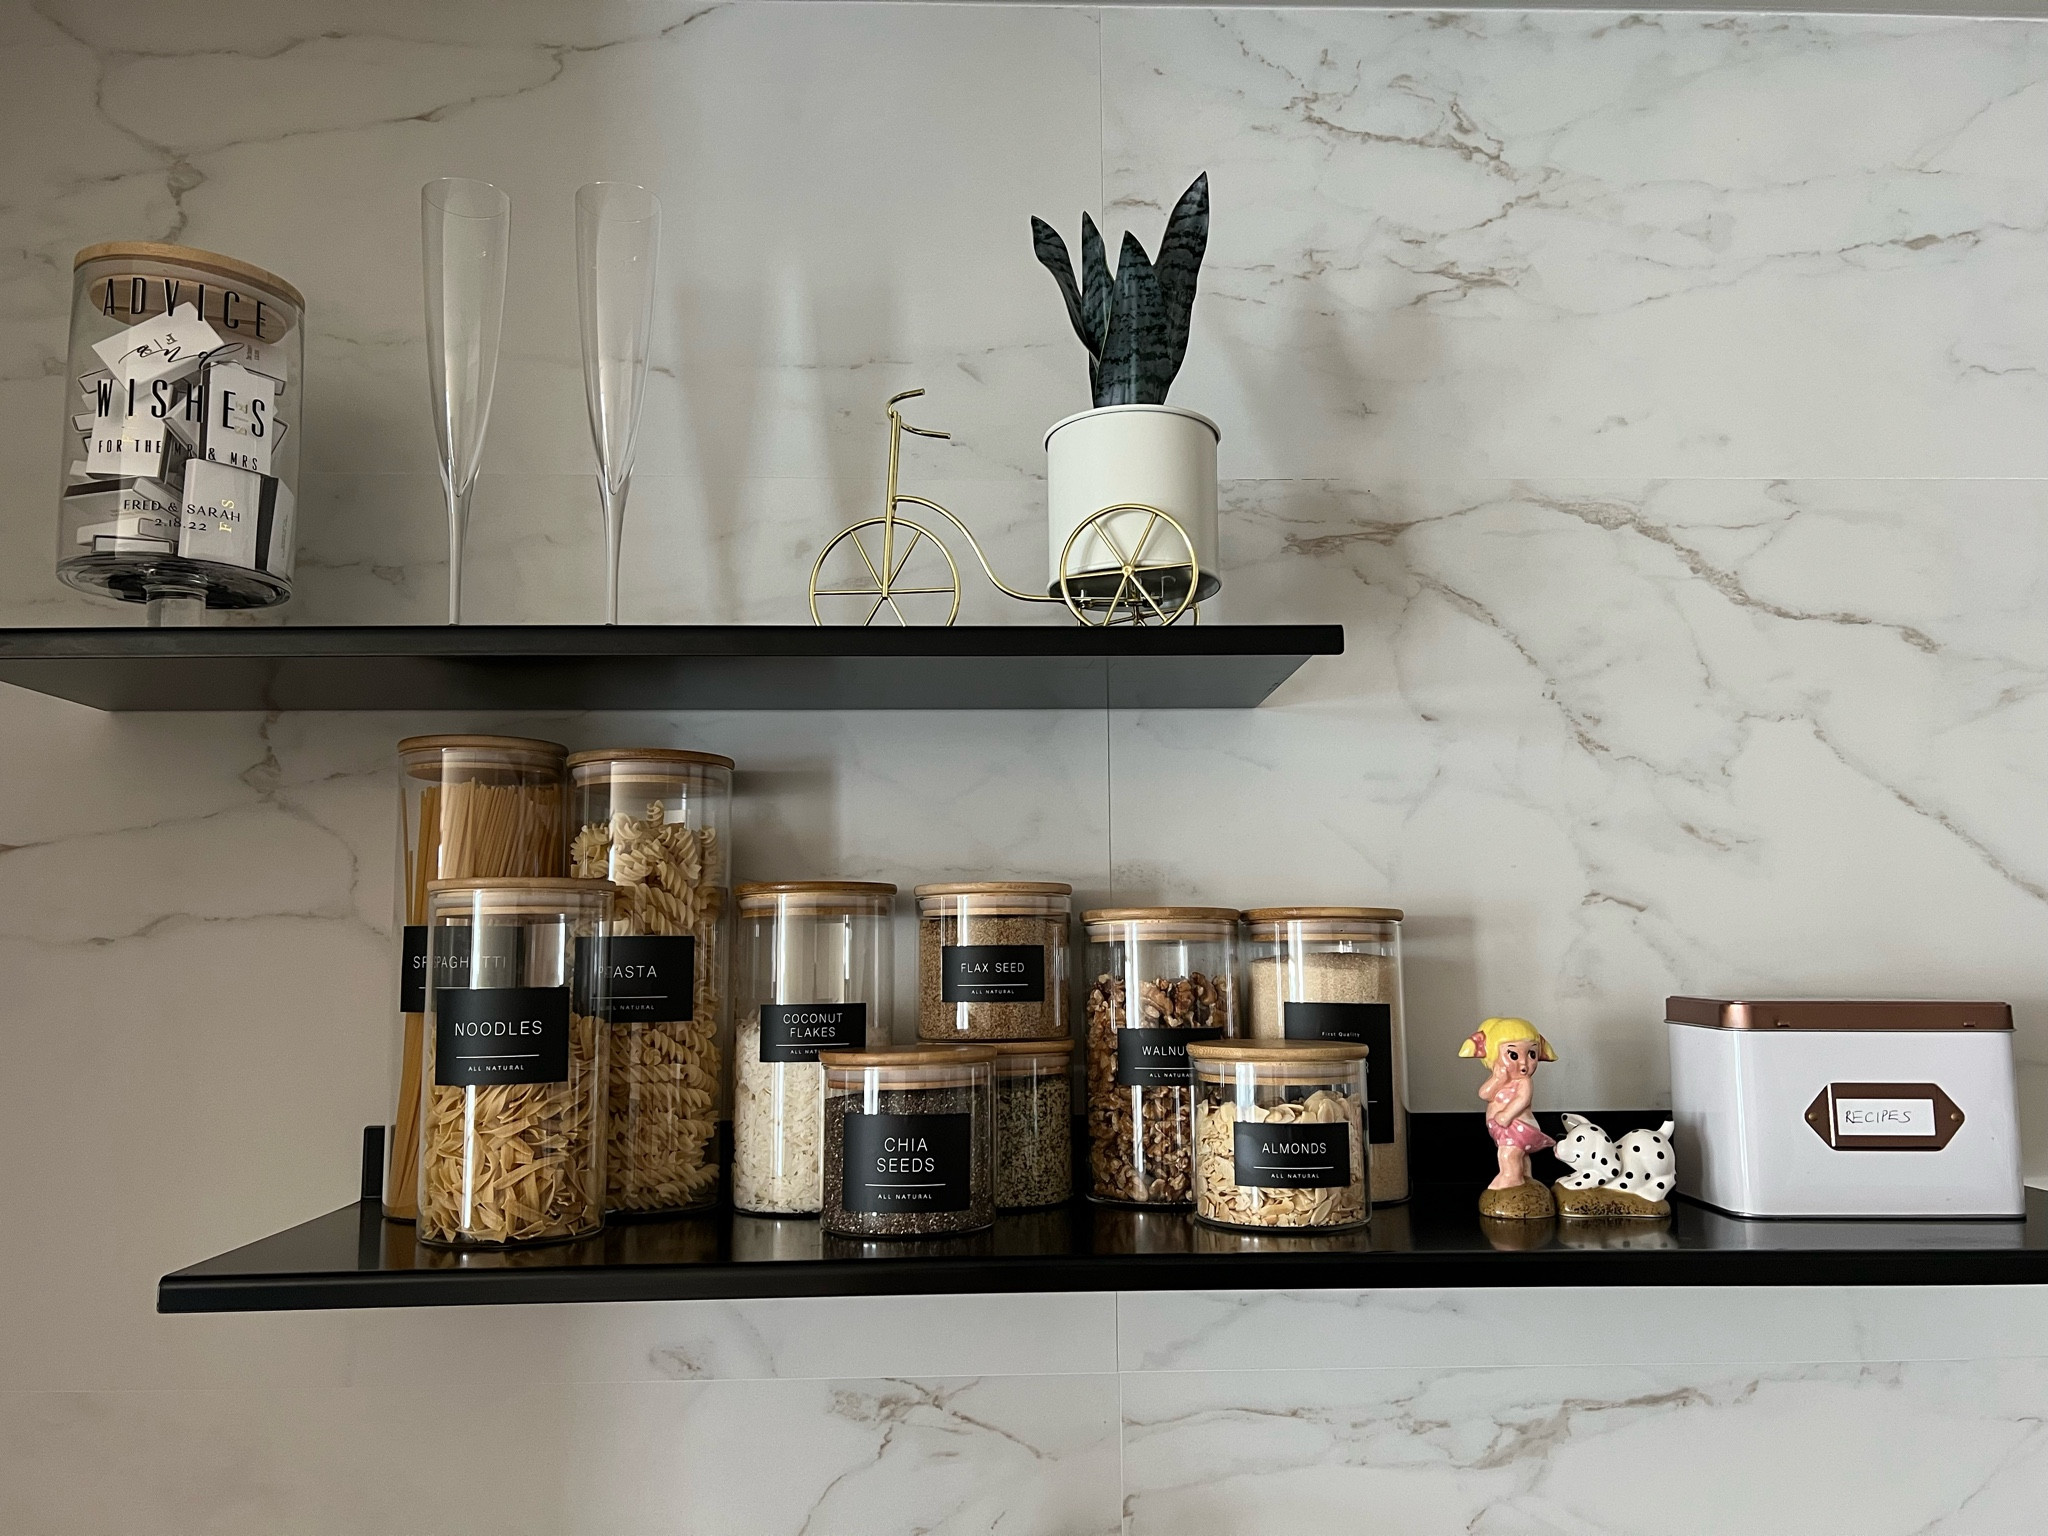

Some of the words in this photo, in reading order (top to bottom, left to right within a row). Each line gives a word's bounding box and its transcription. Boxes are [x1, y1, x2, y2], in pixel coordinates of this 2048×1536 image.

[103, 277, 268, 339] ADVICE
[118, 342, 245, 371] and
[97, 378, 265, 438] WISHES
[99, 439, 122, 453] FOR
[134, 439, 162, 453] THE
[173, 442, 194, 458] MR
[207, 447, 217, 461] &
[230, 451, 259, 471] MRS
[123, 499, 161, 511] FRED
[168, 502, 179, 512] &
[186, 503, 241, 522] SARAH
[154, 518, 208, 532] 2.18.22
[961, 962, 989, 973] FLAX
[995, 962, 1025, 973] SEED
[782, 1012, 844, 1025] COCONUT
[454, 1020, 543, 1037] NOODLES
[789, 1026, 836, 1038] FLAKES
[1141, 1045, 1186, 1057] WALNU
[485, 1064, 525, 1072] NATURAL
[1845, 1110, 1912, 1124] RECIPES
[883, 1137, 928, 1152] CHIA
[1261, 1142, 1327, 1155] ALMONDS
[876, 1157, 936, 1173] SEEDS
